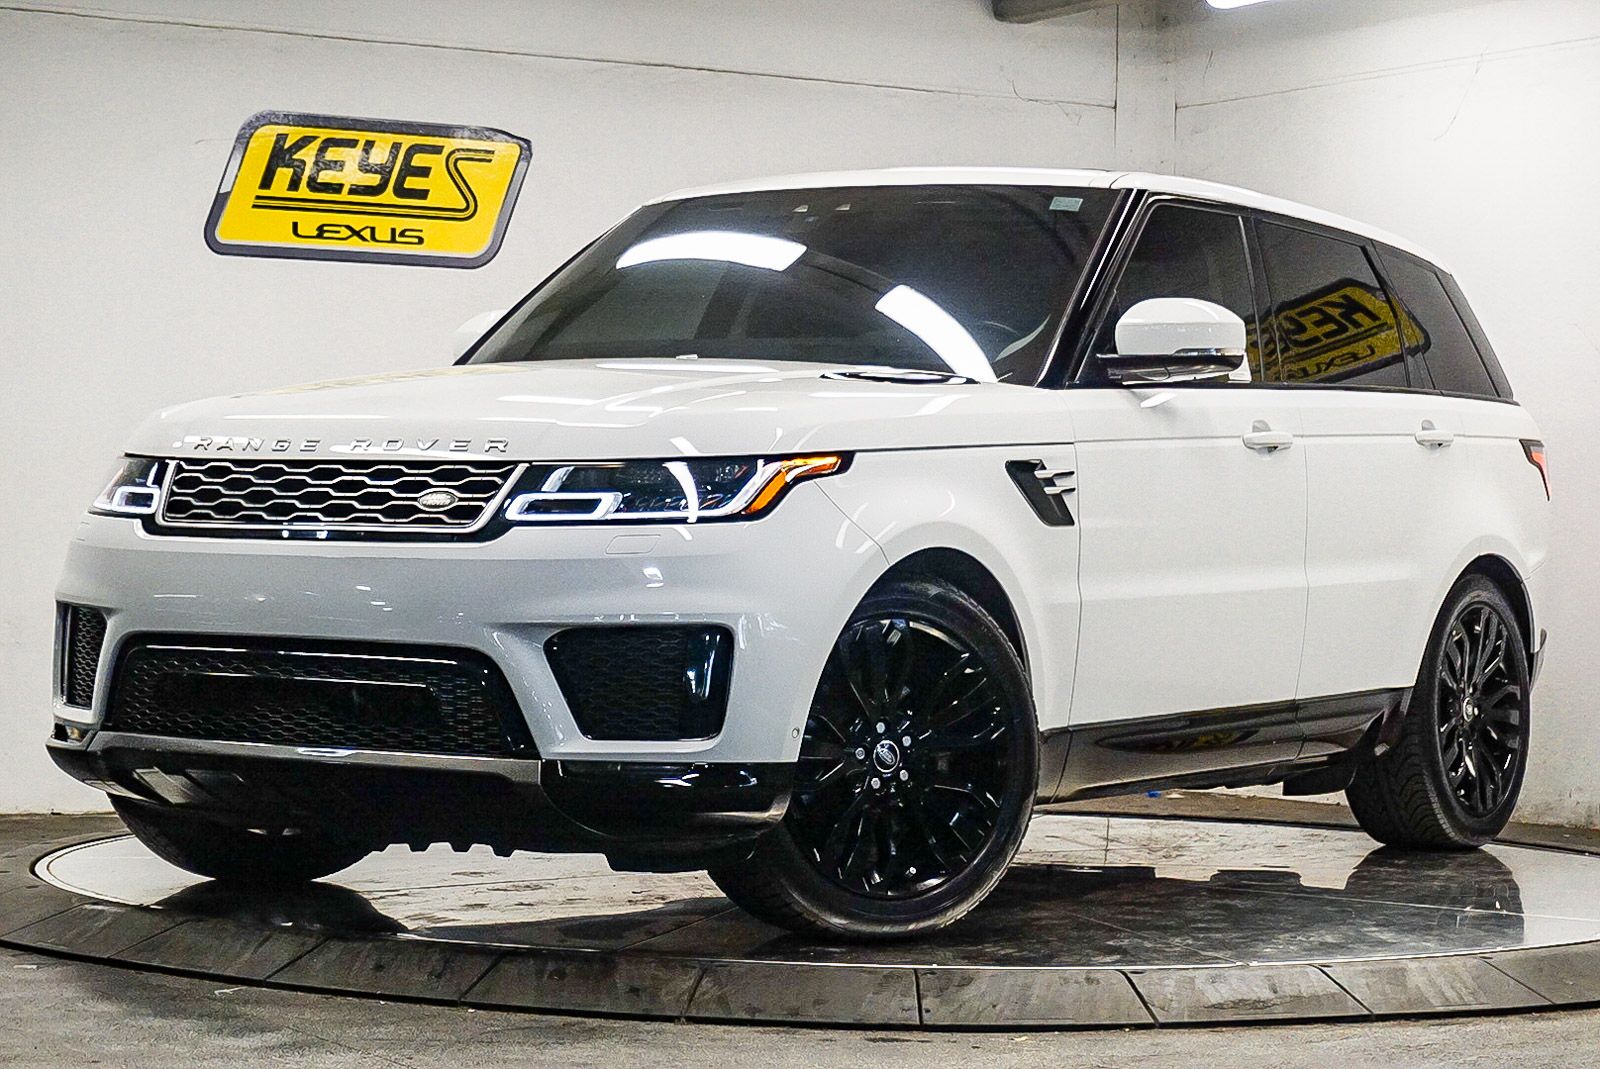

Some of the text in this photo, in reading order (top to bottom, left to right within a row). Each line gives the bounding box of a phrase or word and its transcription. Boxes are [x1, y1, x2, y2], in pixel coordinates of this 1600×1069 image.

[254, 133, 495, 222] KEYES
[292, 221, 424, 245] LEXUS
[194, 438, 508, 453] RANGE ROVER
